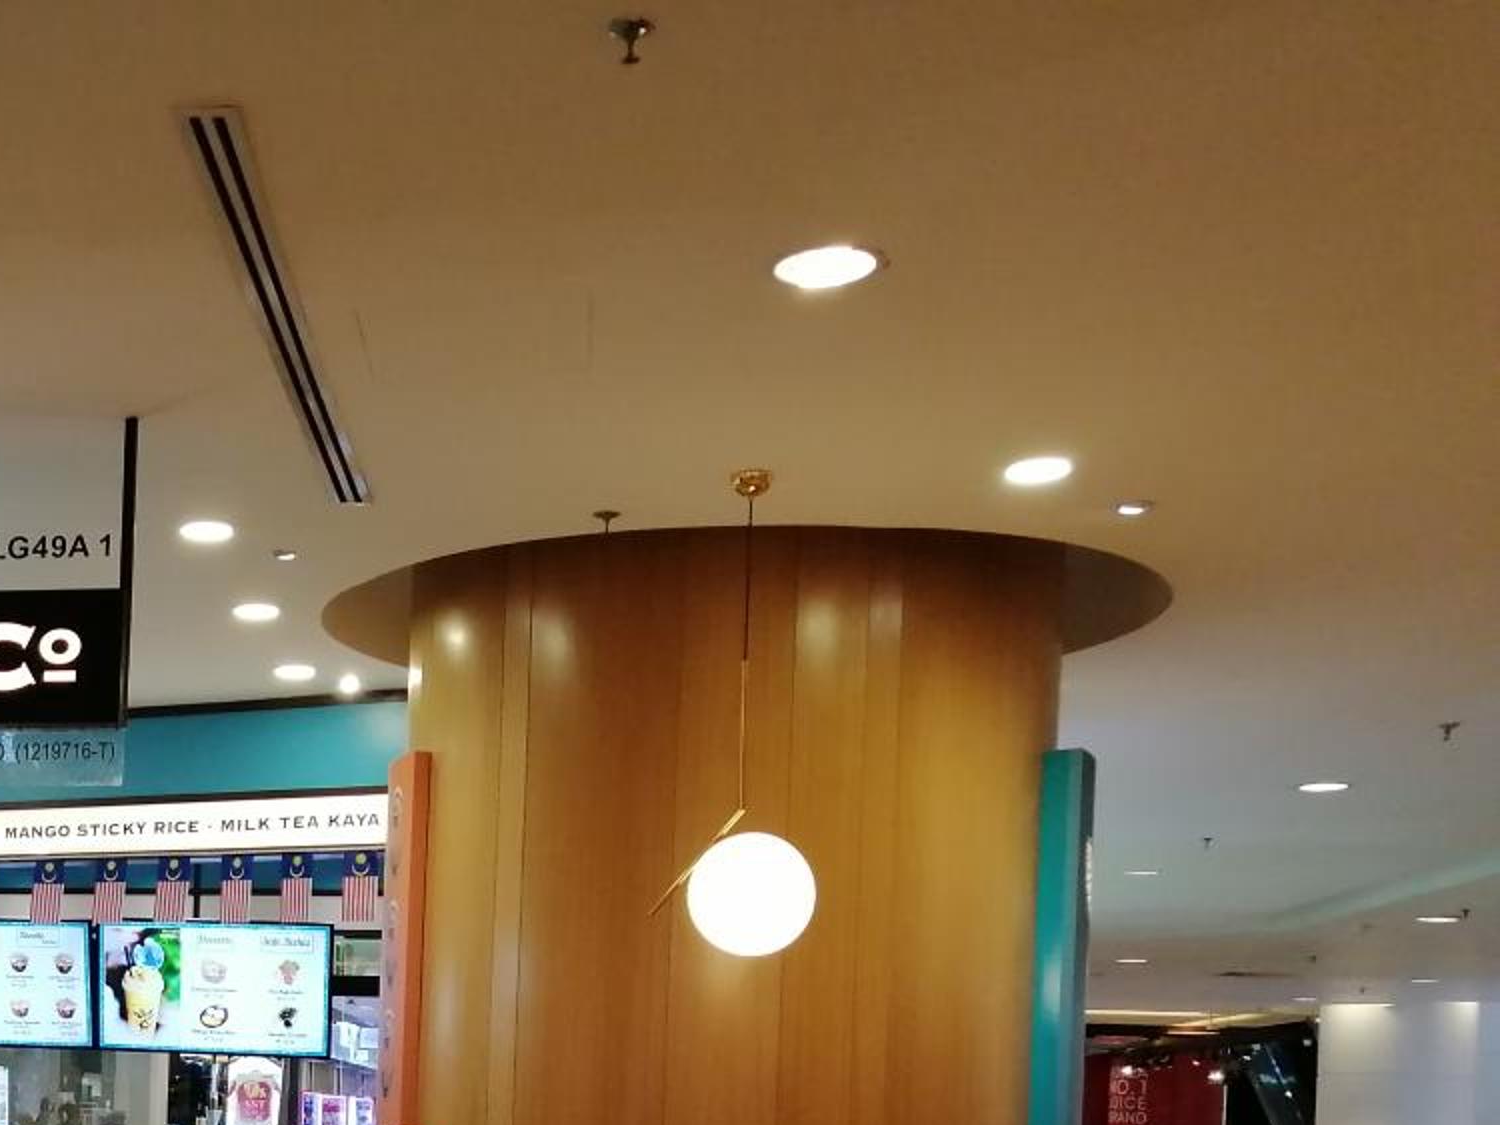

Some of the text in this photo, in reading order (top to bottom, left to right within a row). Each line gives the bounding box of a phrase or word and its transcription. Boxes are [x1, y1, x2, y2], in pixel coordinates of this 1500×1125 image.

[99, 534, 111, 557] 1
[14, 742, 116, 765] (1219716-T)
[5, 824, 71, 840] MANGO
[76, 821, 147, 837] STICKY
[153, 820, 200, 835] RICE
[220, 817, 271, 833] MILK
[278, 814, 320, 830] TEA
[328, 812, 380, 828] KAYA
